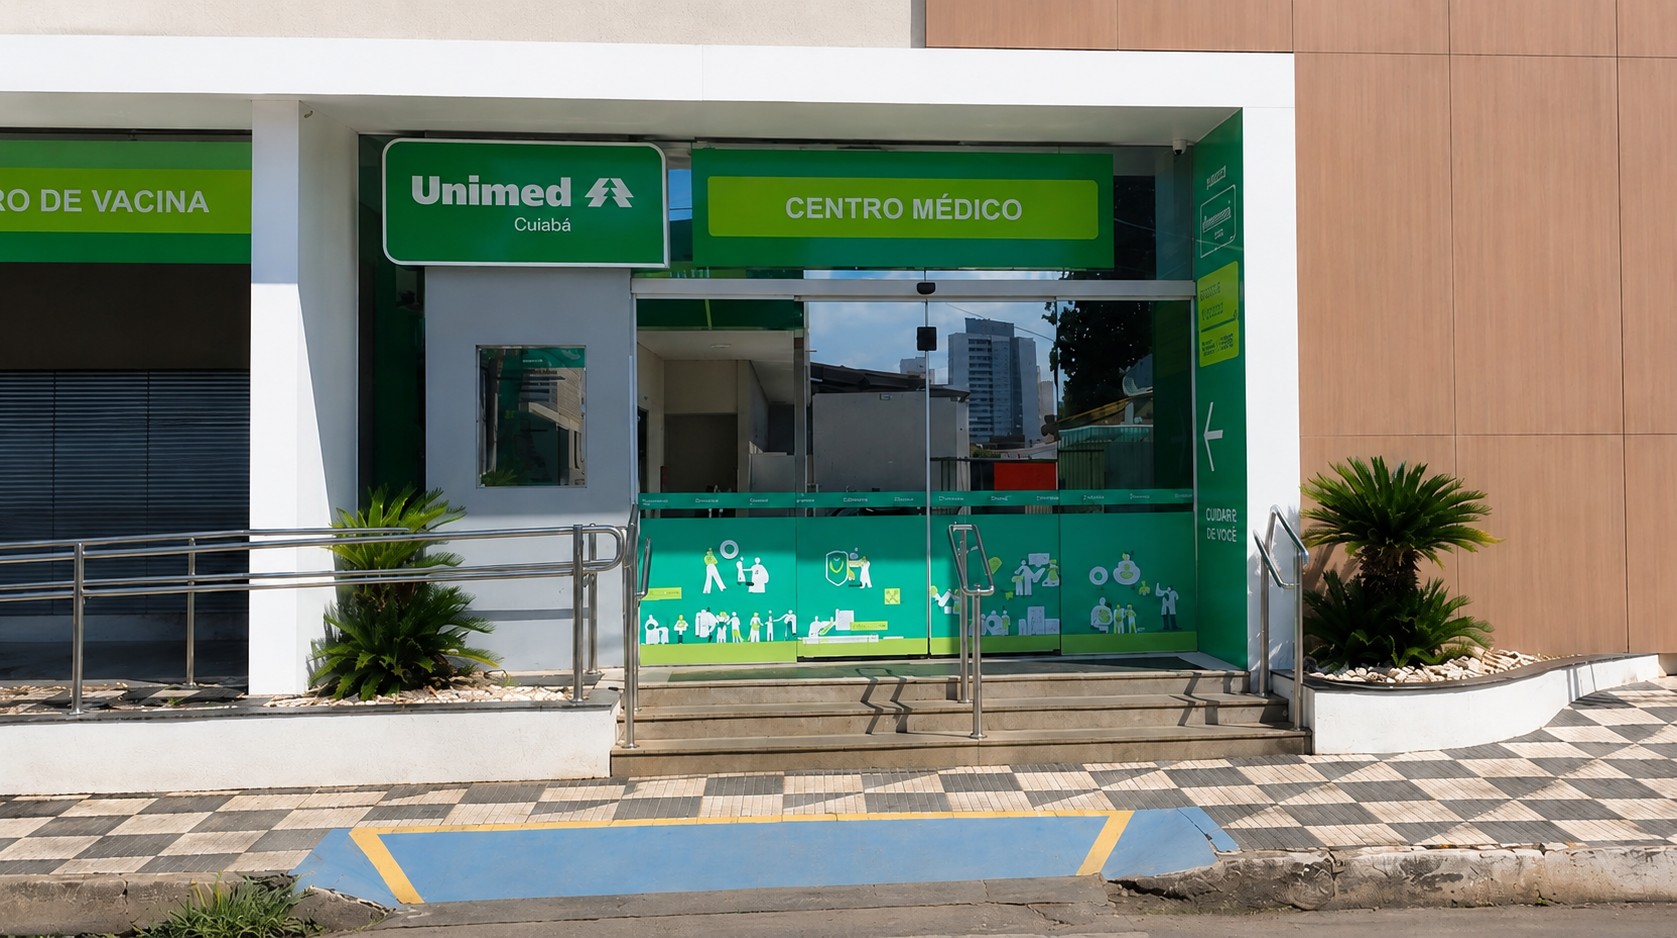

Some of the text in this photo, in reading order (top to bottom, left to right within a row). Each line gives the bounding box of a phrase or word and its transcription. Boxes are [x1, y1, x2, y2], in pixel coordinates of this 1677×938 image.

[0, 188, 210, 213] O DE VACINA
[411, 175, 572, 207] Unimed
[785, 193, 1023, 220] CENTRO MÉDICO
[514, 217, 571, 232] Cuiabá
